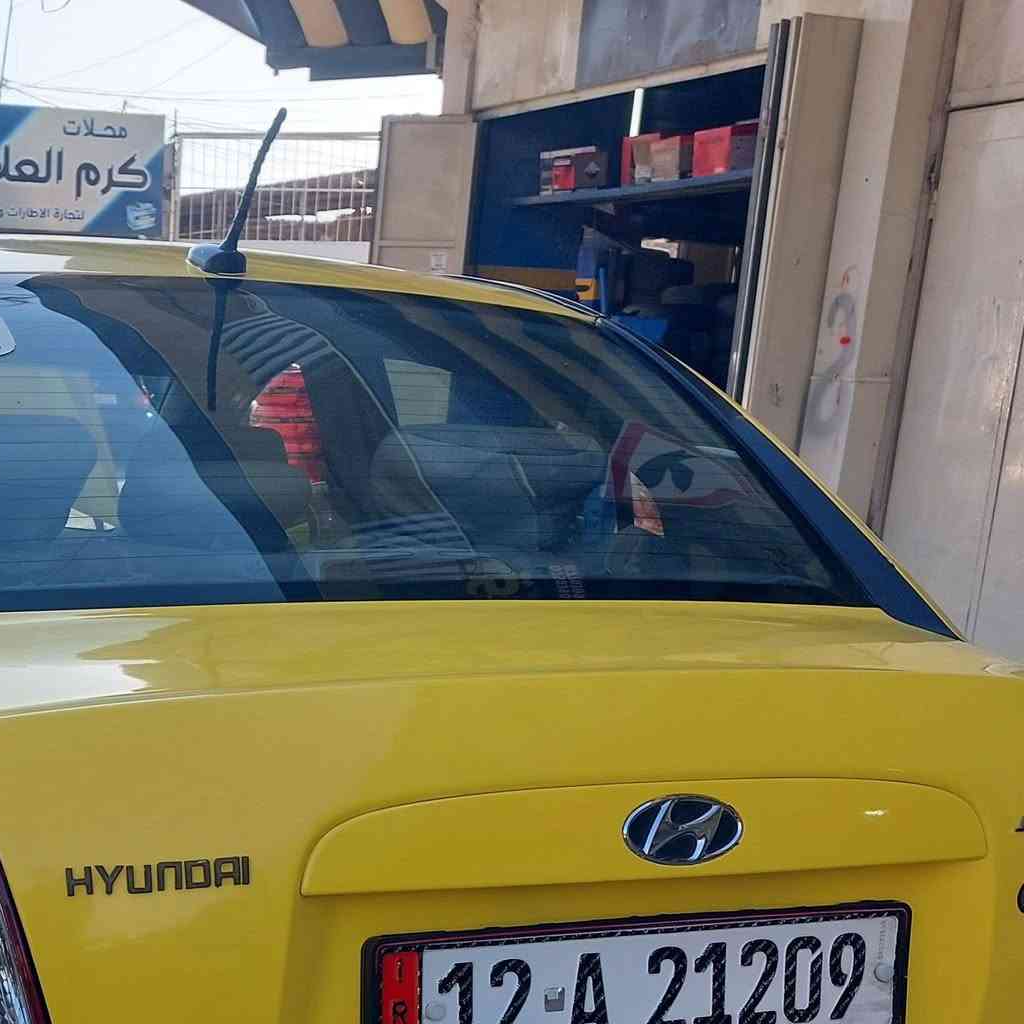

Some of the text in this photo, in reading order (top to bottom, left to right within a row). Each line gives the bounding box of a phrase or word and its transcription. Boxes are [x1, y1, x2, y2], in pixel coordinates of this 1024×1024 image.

[63, 117, 128, 138] محلات
[74, 153, 148, 200] كرم
[64, 855, 251, 897] HYUNDAI
